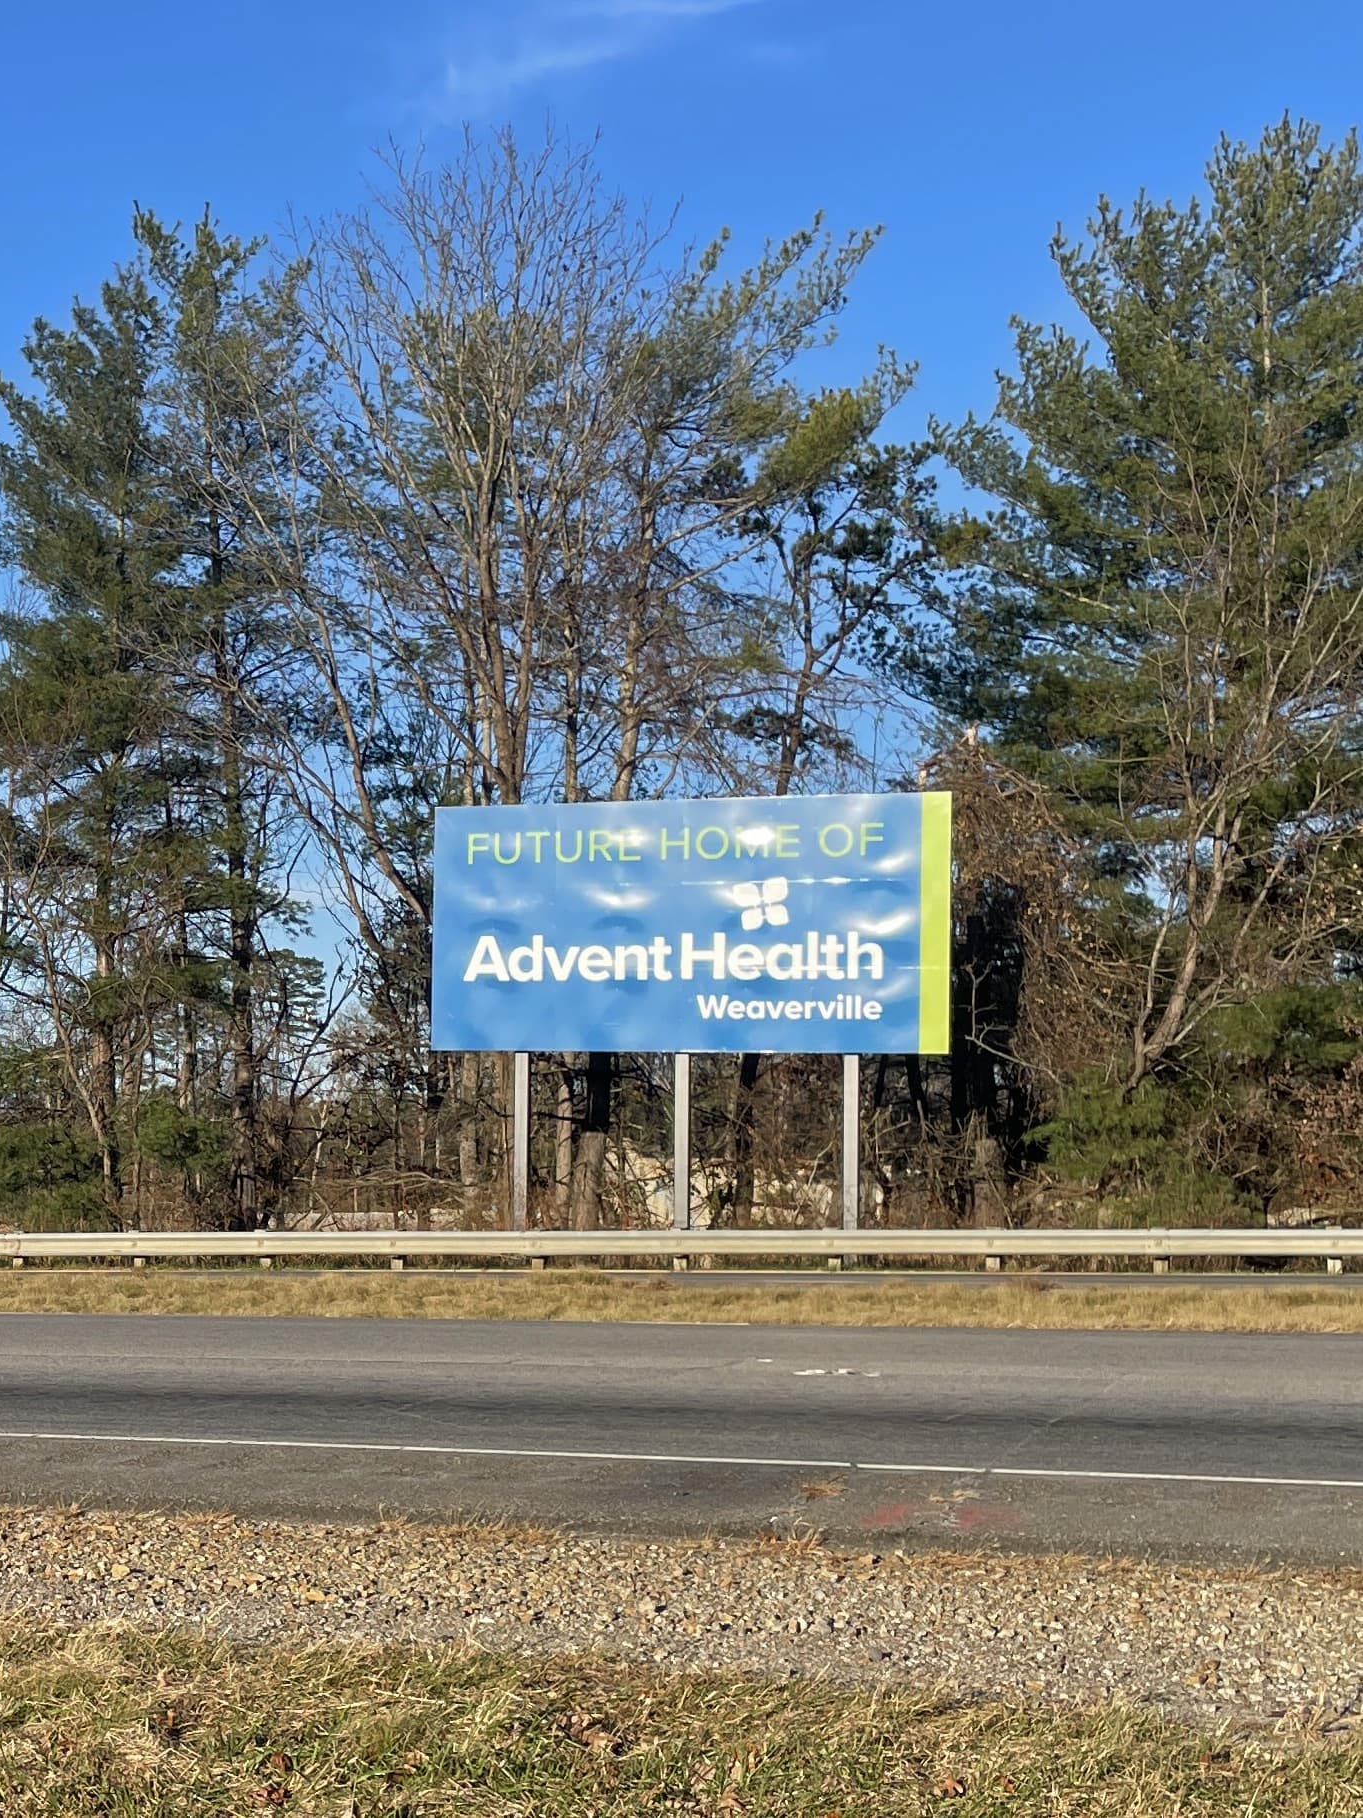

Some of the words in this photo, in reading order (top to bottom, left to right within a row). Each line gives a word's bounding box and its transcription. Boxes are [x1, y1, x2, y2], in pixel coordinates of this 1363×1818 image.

[467, 830, 641, 865] FUTURE
[660, 824, 800, 860] HOME
[818, 821, 885, 857] OF
[696, 994, 883, 1020] Weaverville
